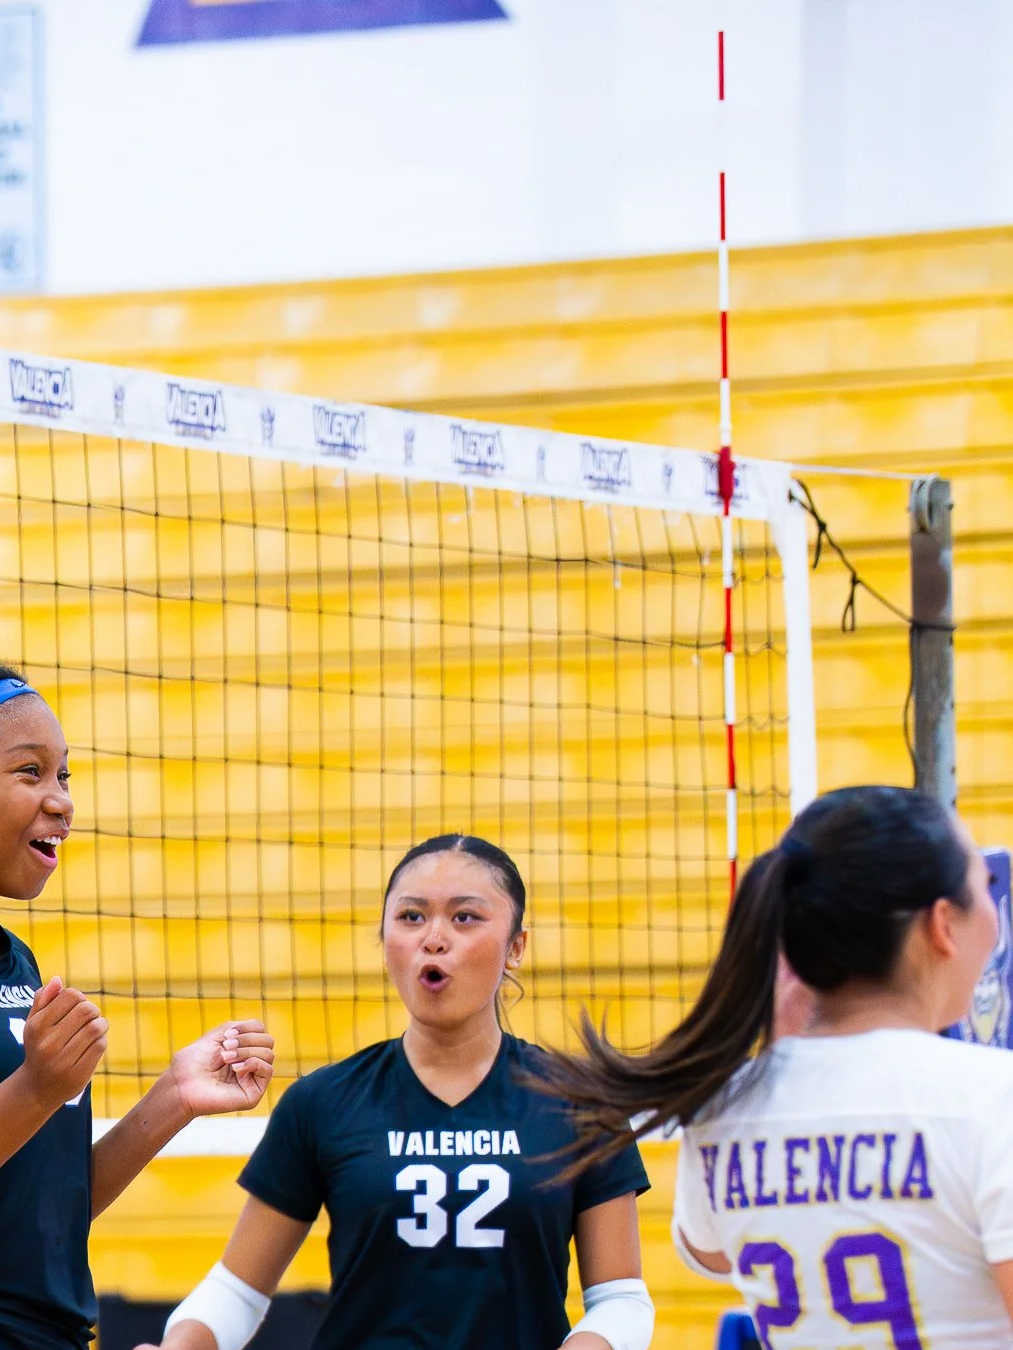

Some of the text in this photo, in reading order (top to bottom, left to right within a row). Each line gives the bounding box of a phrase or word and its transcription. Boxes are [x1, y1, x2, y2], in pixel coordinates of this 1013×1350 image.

[10, 358, 73, 410] VALENCIA
[387, 1129, 521, 1157] VALENCIA
[699, 1132, 934, 1212] VALENCIA
[395, 1163, 510, 1248] 32
